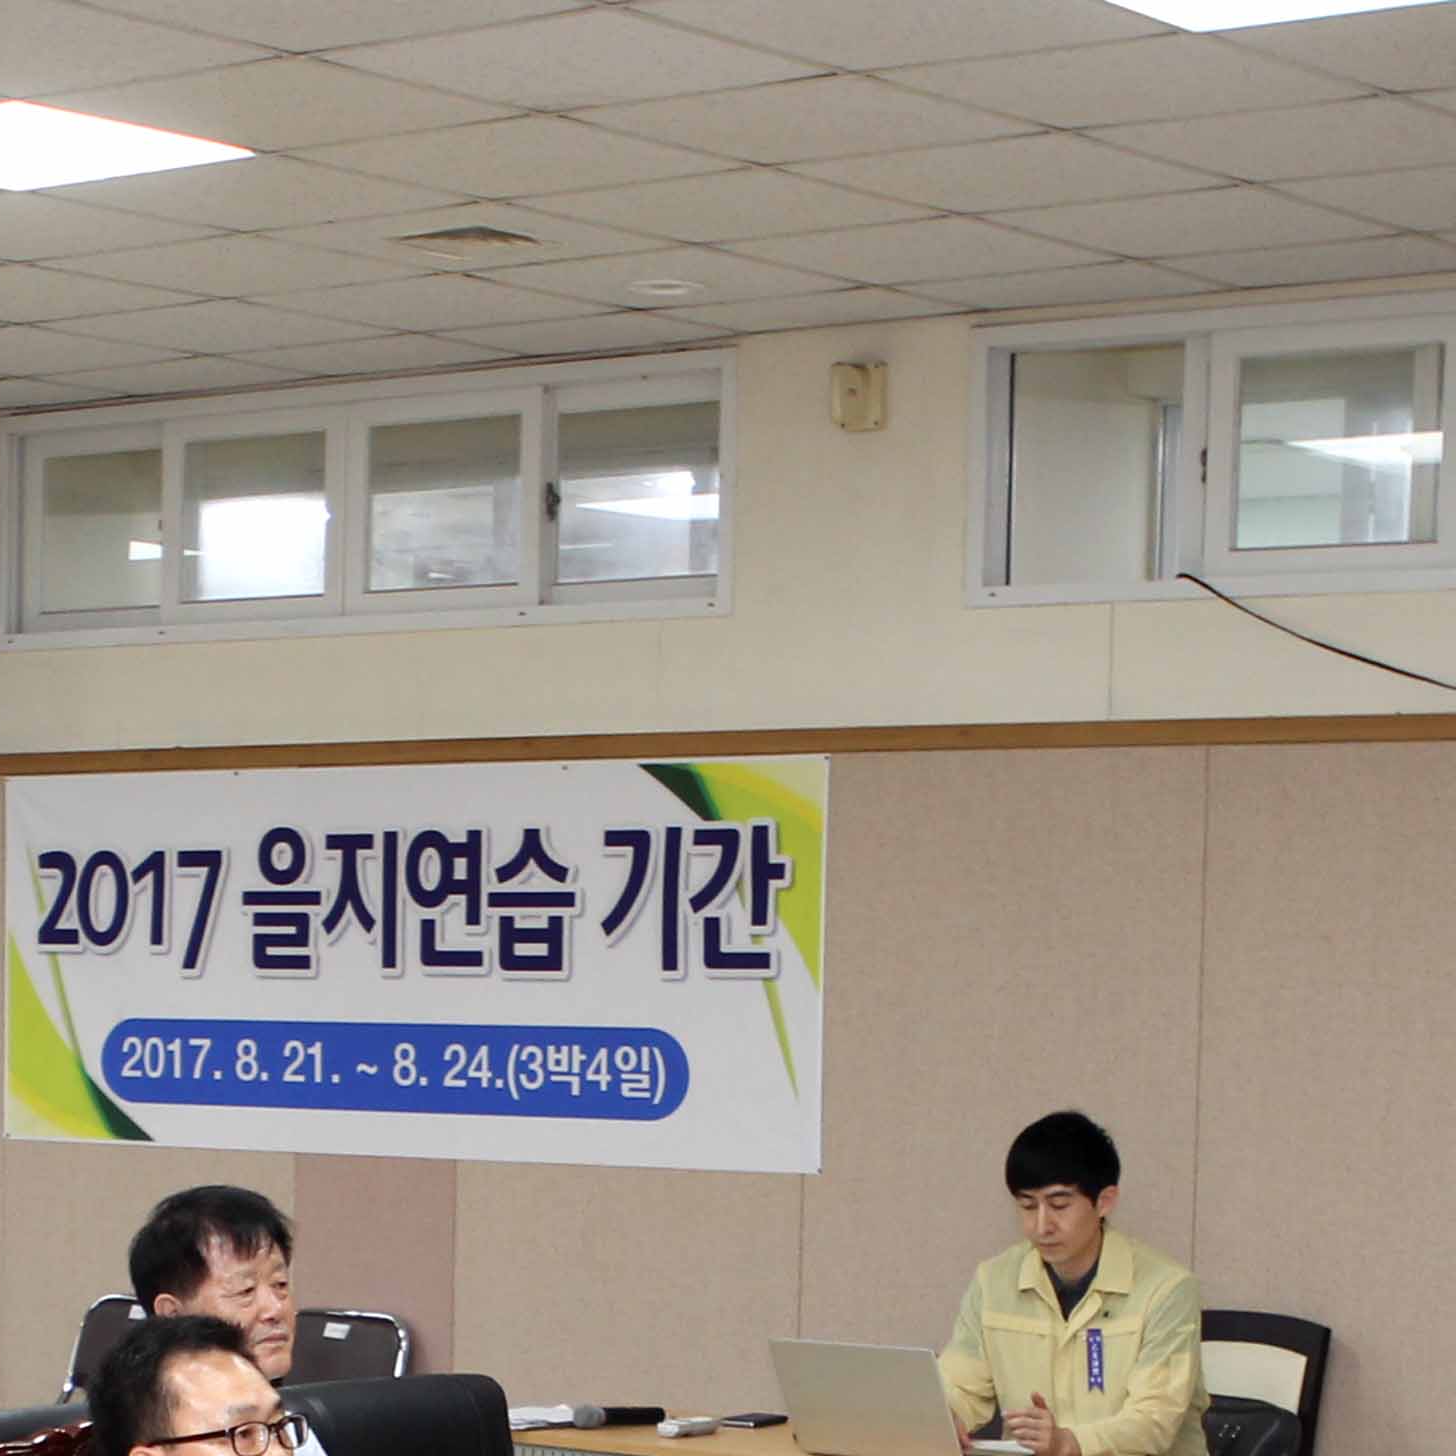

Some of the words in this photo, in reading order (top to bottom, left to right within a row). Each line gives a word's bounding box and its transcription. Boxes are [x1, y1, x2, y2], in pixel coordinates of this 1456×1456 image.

[34, 849, 229, 974] 2017
[240, 825, 578, 973] 을지연습
[599, 824, 788, 974] 기간
[120, 1036, 223, 1081] 2017.
[235, 1039, 270, 1083] 8.
[282, 1041, 341, 1085] 21.
[392, 1043, 430, 1088] 8.
